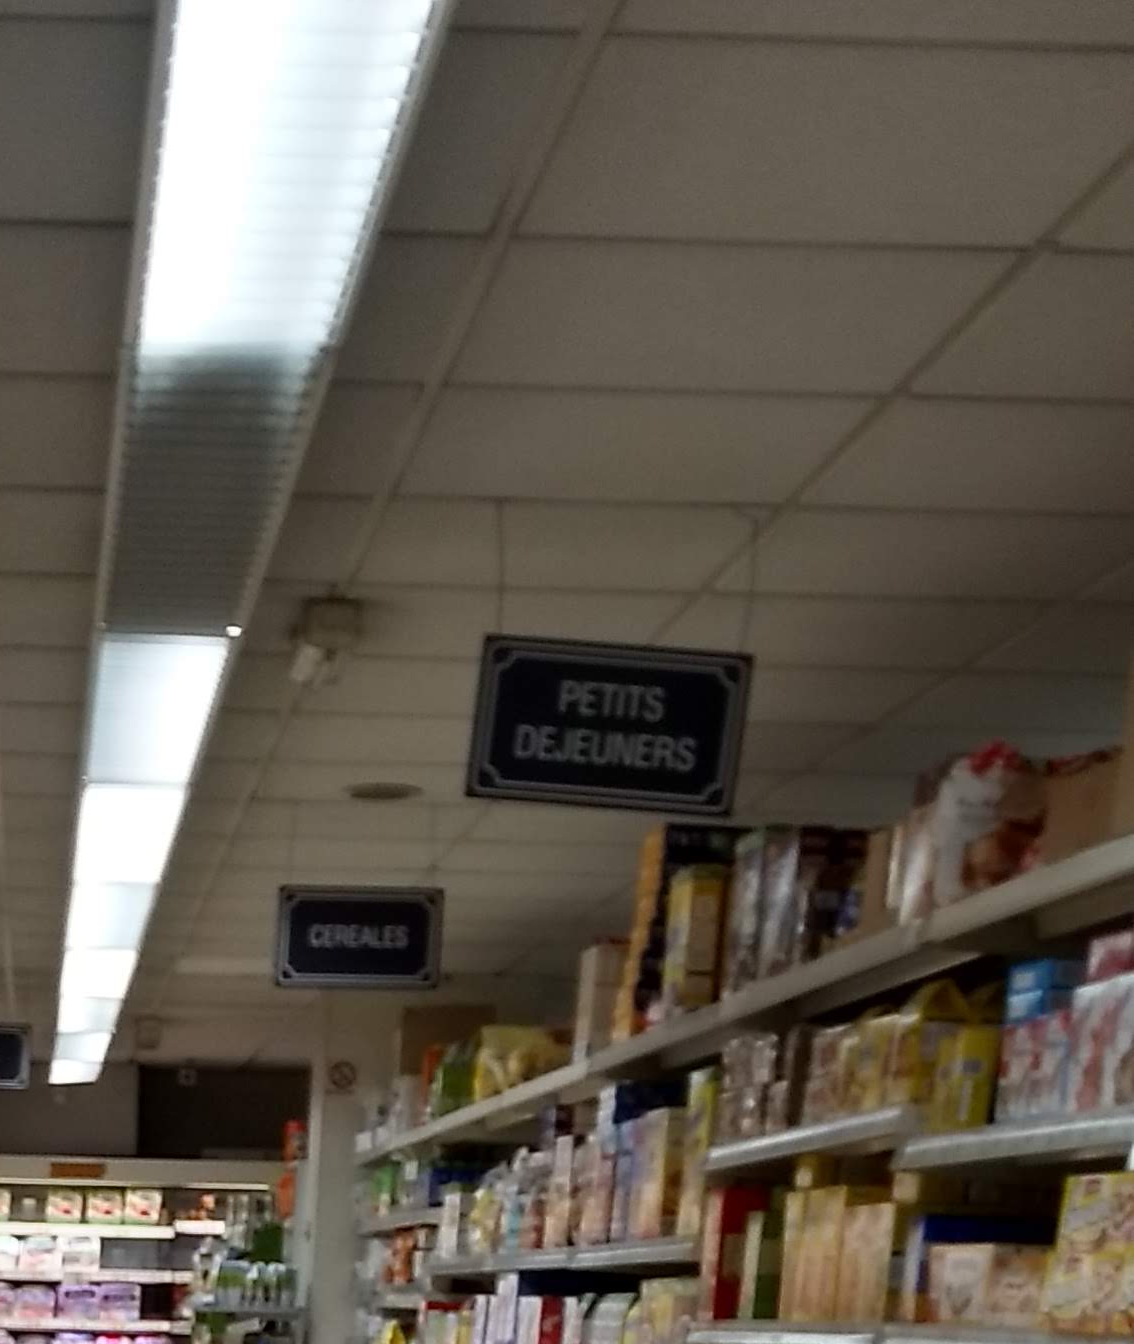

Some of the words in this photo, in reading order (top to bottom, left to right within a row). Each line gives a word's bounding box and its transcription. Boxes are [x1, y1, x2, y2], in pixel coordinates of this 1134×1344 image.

[557, 679, 666, 722] PETITS
[513, 724, 697, 772] DEJEUNERS
[309, 922, 409, 949] CEREALES
